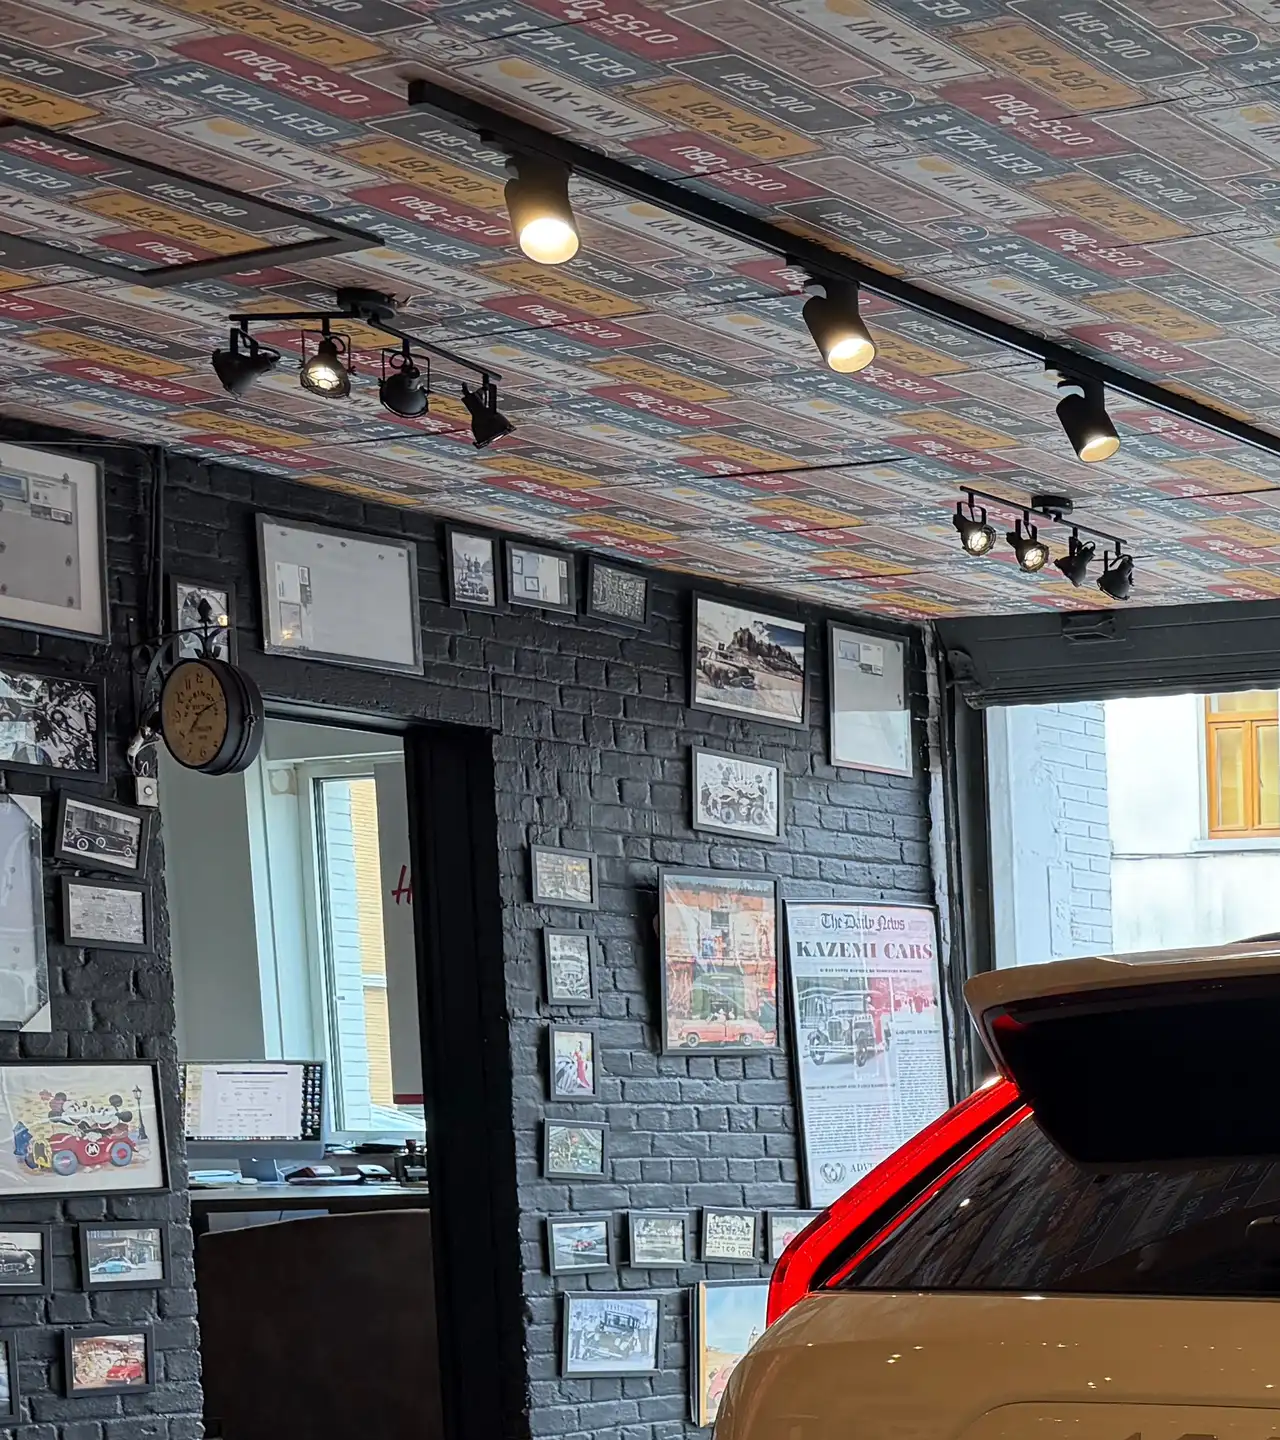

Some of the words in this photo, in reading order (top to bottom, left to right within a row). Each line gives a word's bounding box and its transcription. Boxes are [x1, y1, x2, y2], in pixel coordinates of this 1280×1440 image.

[1206, 31, 1251, 46] 15
[98, 48, 147, 62] 15
[862, 89, 906, 103] 15
[821, 913, 842, 929] The
[843, 913, 875, 930] Daily
[876, 915, 905, 932] News
[796, 941, 876, 959] KAZEMI
[884, 943, 933, 959] CARS
